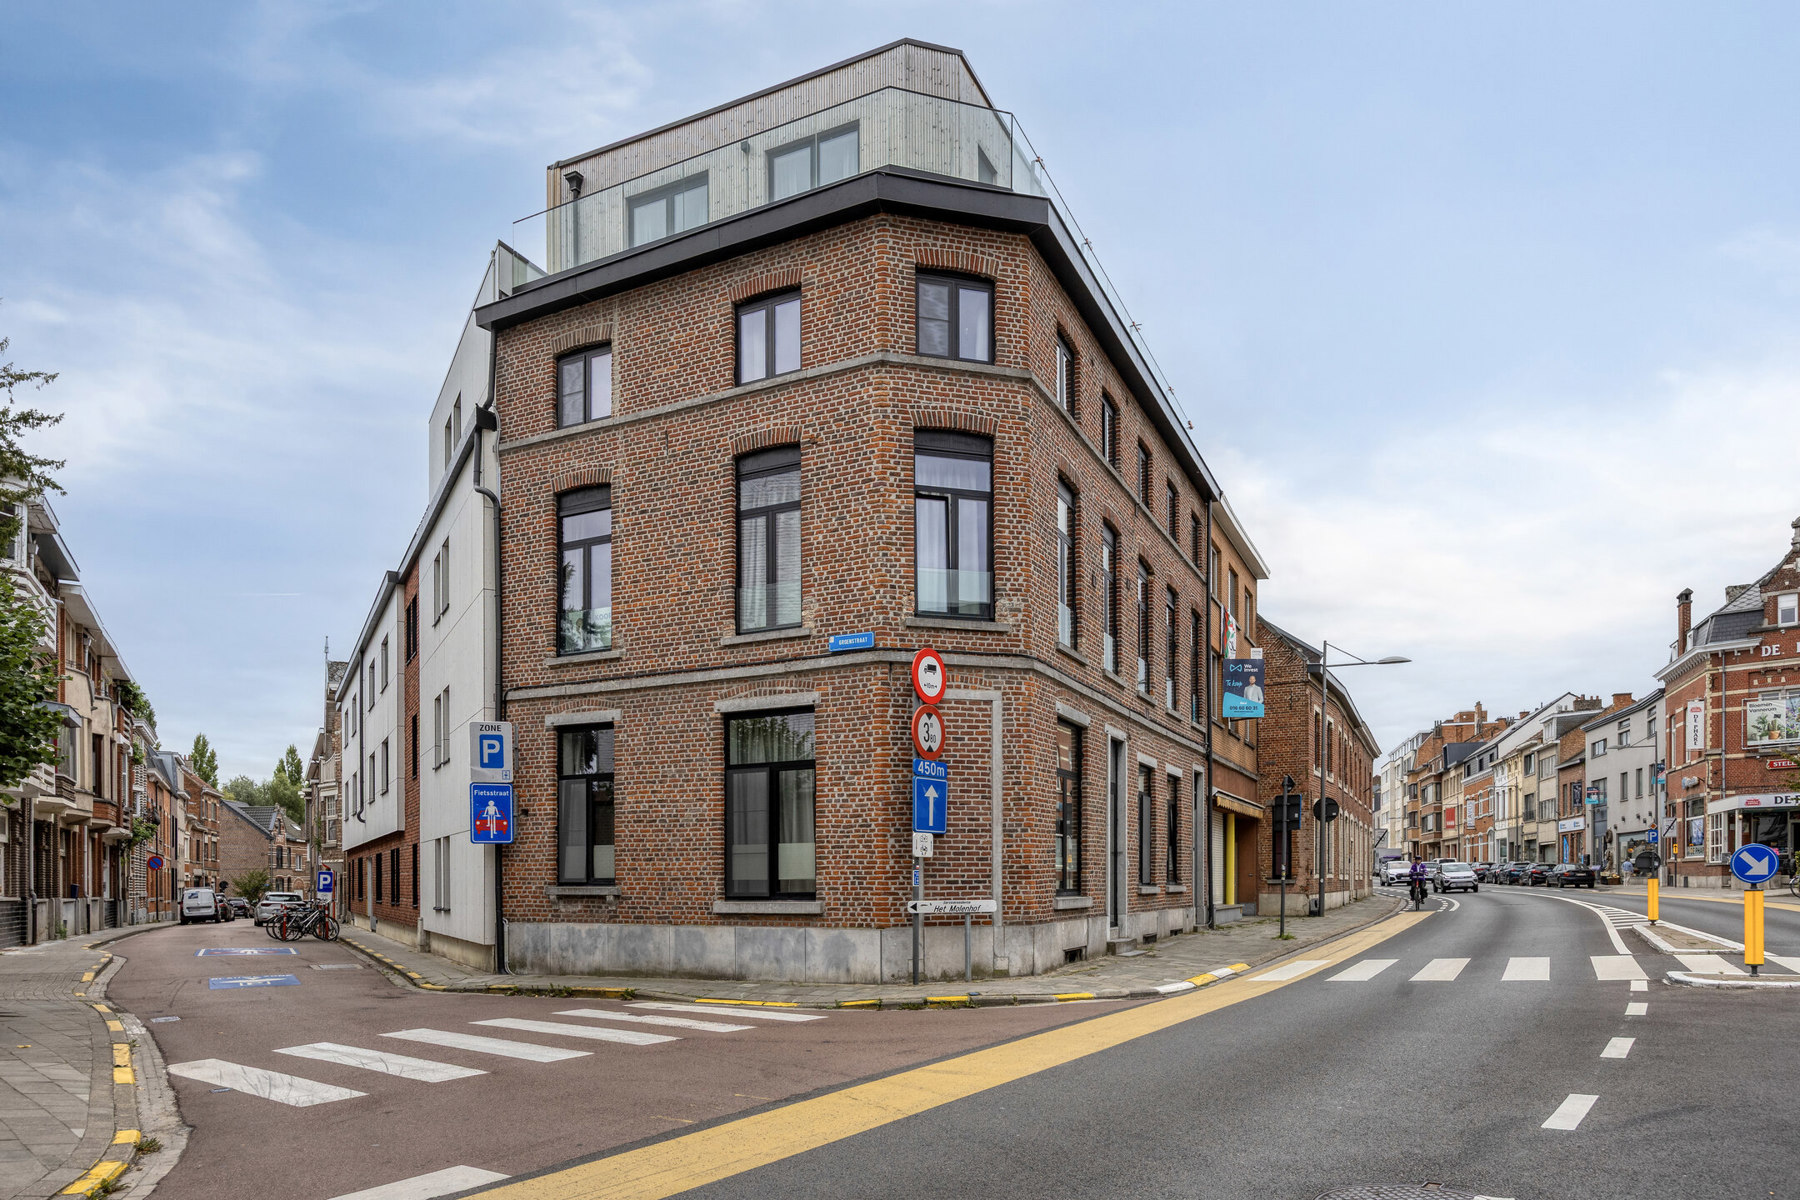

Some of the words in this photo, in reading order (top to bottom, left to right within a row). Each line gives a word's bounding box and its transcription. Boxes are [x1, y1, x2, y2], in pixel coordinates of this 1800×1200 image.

[1761, 644, 1780, 657] DE
[923, 722, 930, 743] 3
[930, 734, 937, 744] 80
[482, 740, 500, 763] P
[917, 760, 945, 777] 450m
[1774, 795, 1791, 805] DE
[1649, 831, 1657, 841] P
[319, 874, 331, 890] P
